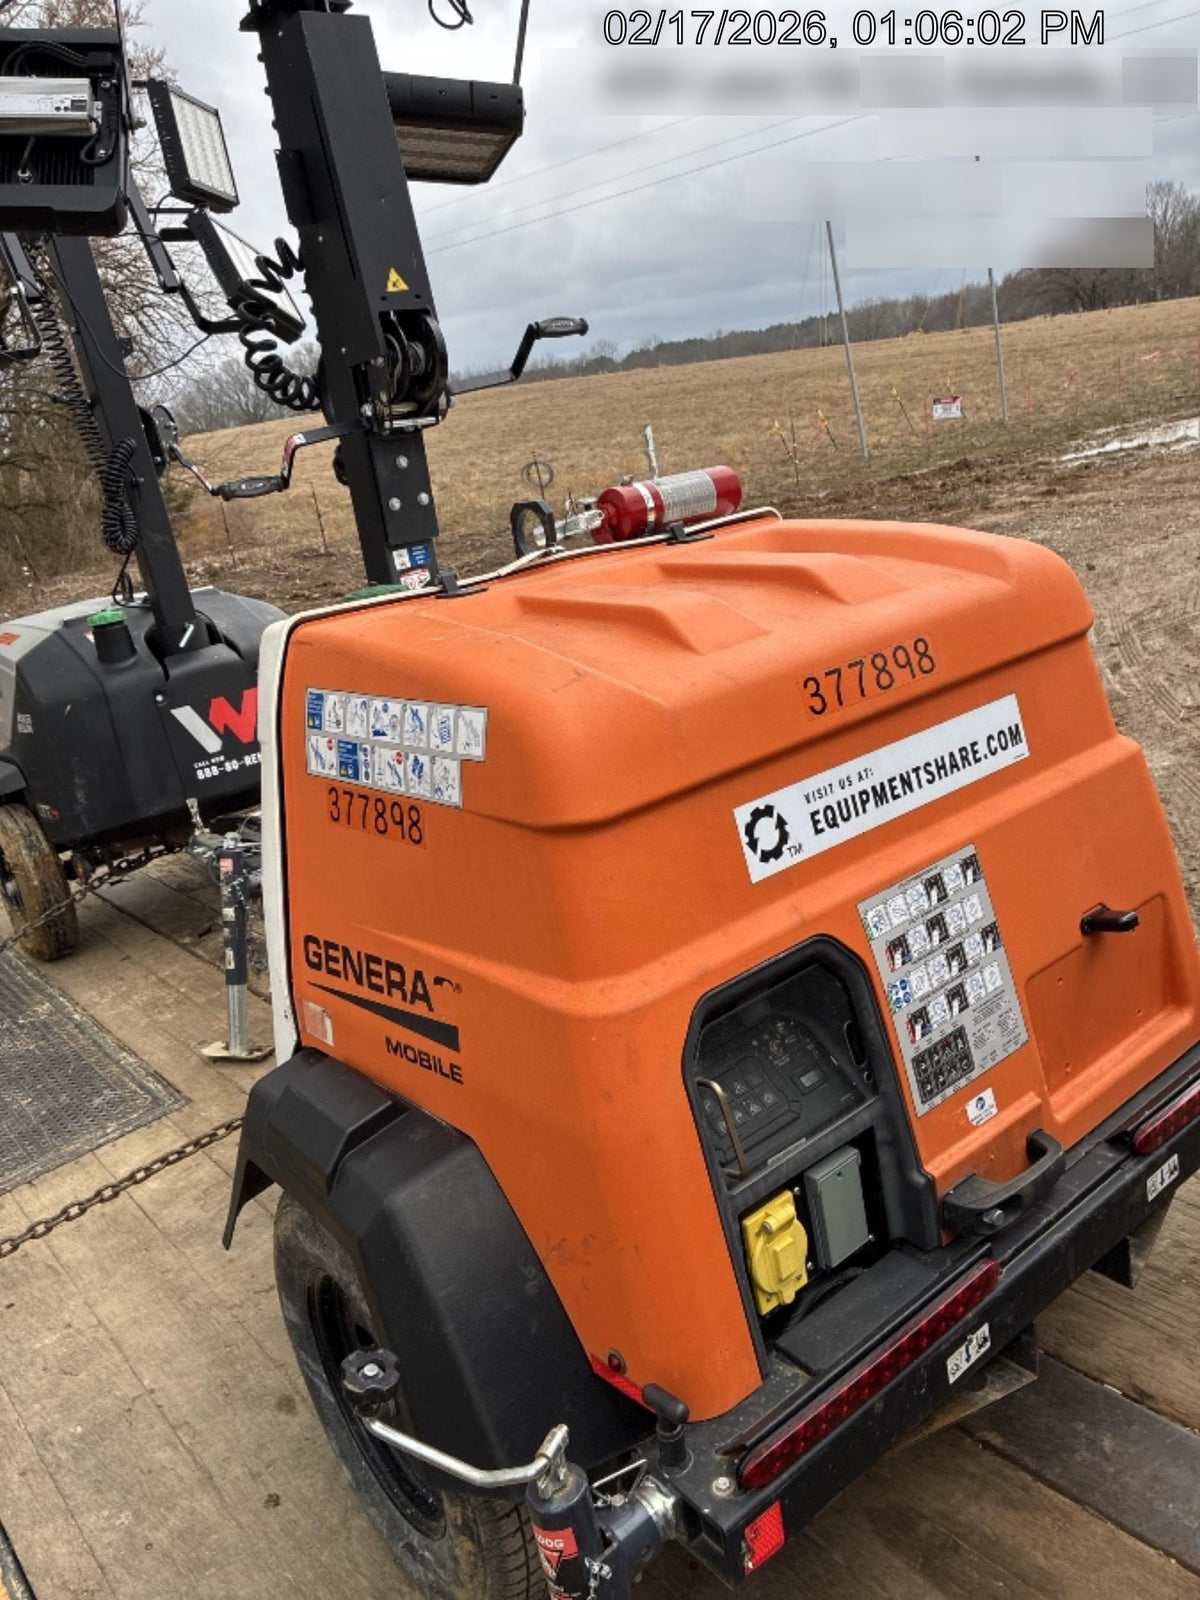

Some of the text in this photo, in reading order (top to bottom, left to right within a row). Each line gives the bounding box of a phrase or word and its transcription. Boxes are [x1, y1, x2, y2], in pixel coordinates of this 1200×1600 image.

[803, 637, 935, 715] 377898
[804, 783, 834, 804] VISIT
[839, 775, 853, 790] US
[809, 723, 1024, 836] EQUIPMENTSHARE.COM
[328, 787, 424, 845] 377898
[385, 1036, 465, 1085] MOBILE
